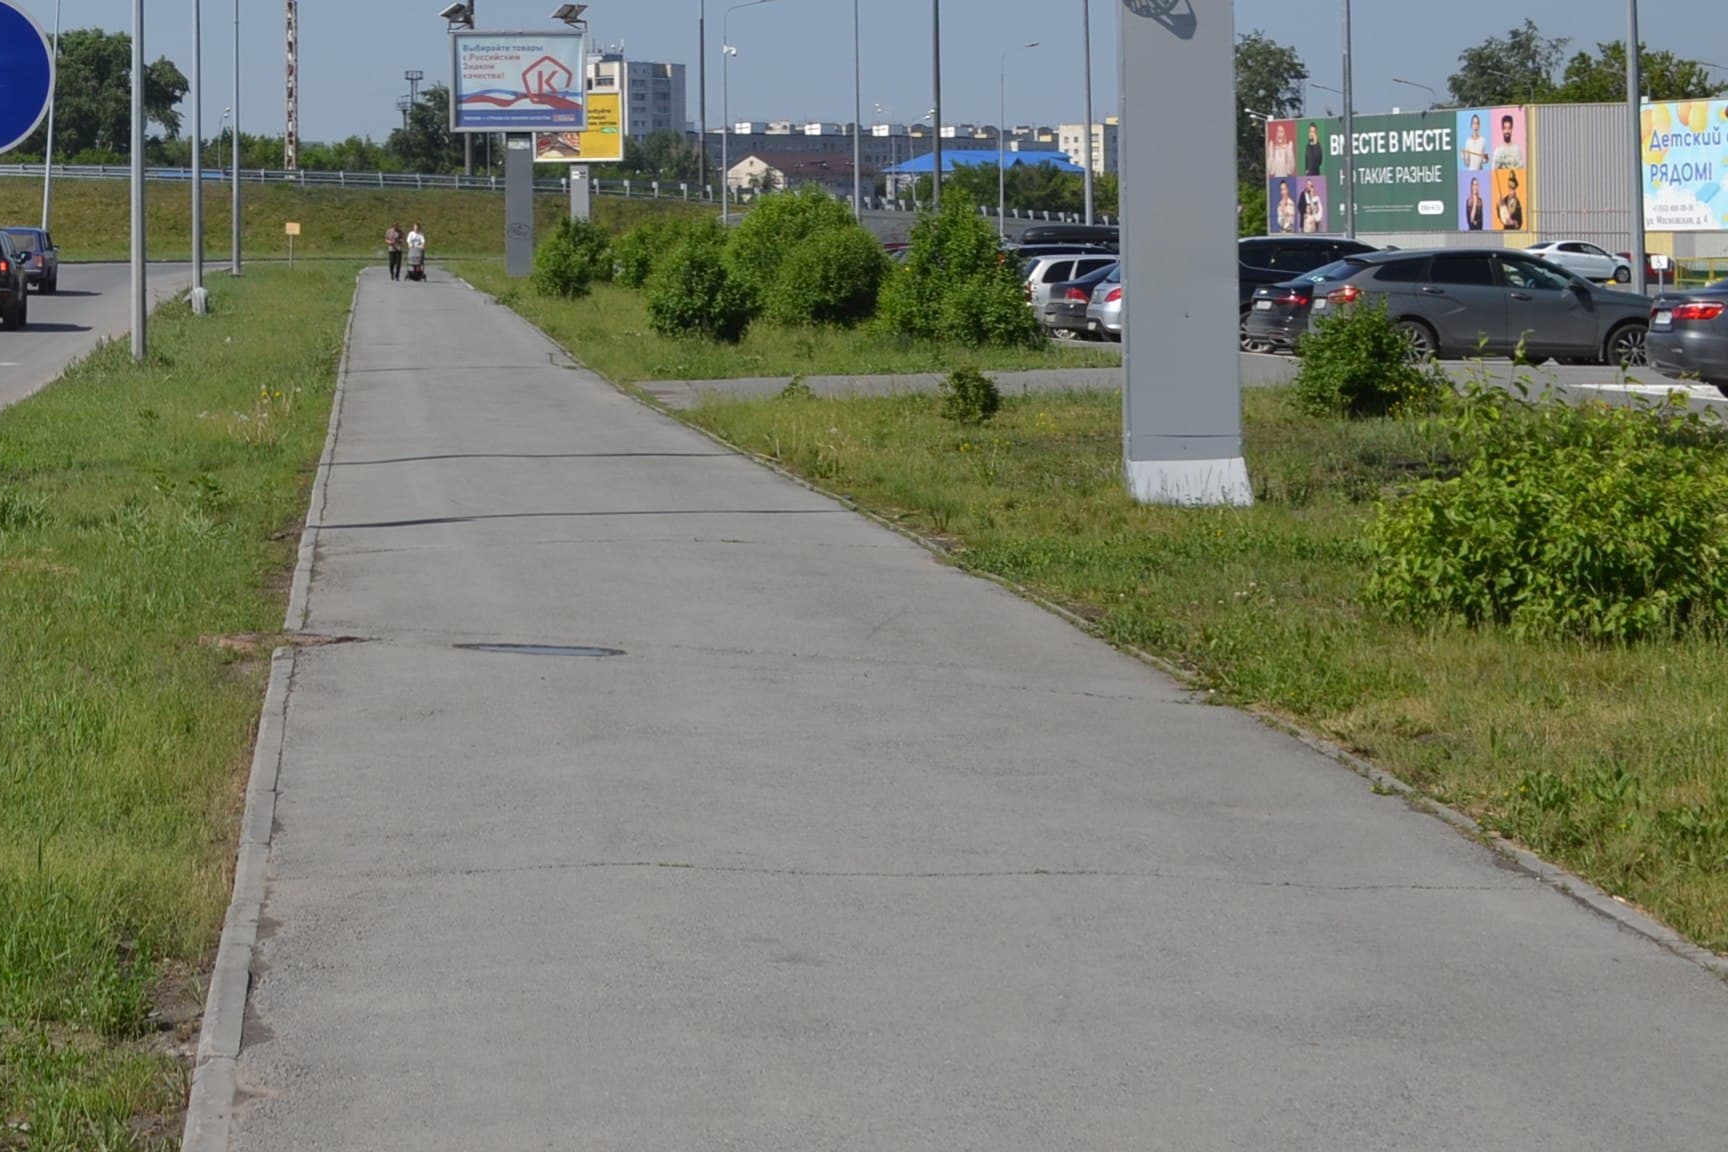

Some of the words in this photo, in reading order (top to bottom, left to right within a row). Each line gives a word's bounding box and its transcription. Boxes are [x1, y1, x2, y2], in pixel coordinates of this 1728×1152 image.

[463, 44, 510, 53] Выбирайте
[512, 45, 544, 53] товары
[1389, 131, 1399, 153] В
[1402, 128, 1452, 152] МЕСТЕ
[1649, 126, 1721, 151] Детский
[1358, 166, 1394, 184] ТАКИЕ
[1396, 164, 1443, 184] РАЗНЫЕ
[1651, 162, 1712, 186] РЯДОМ!
